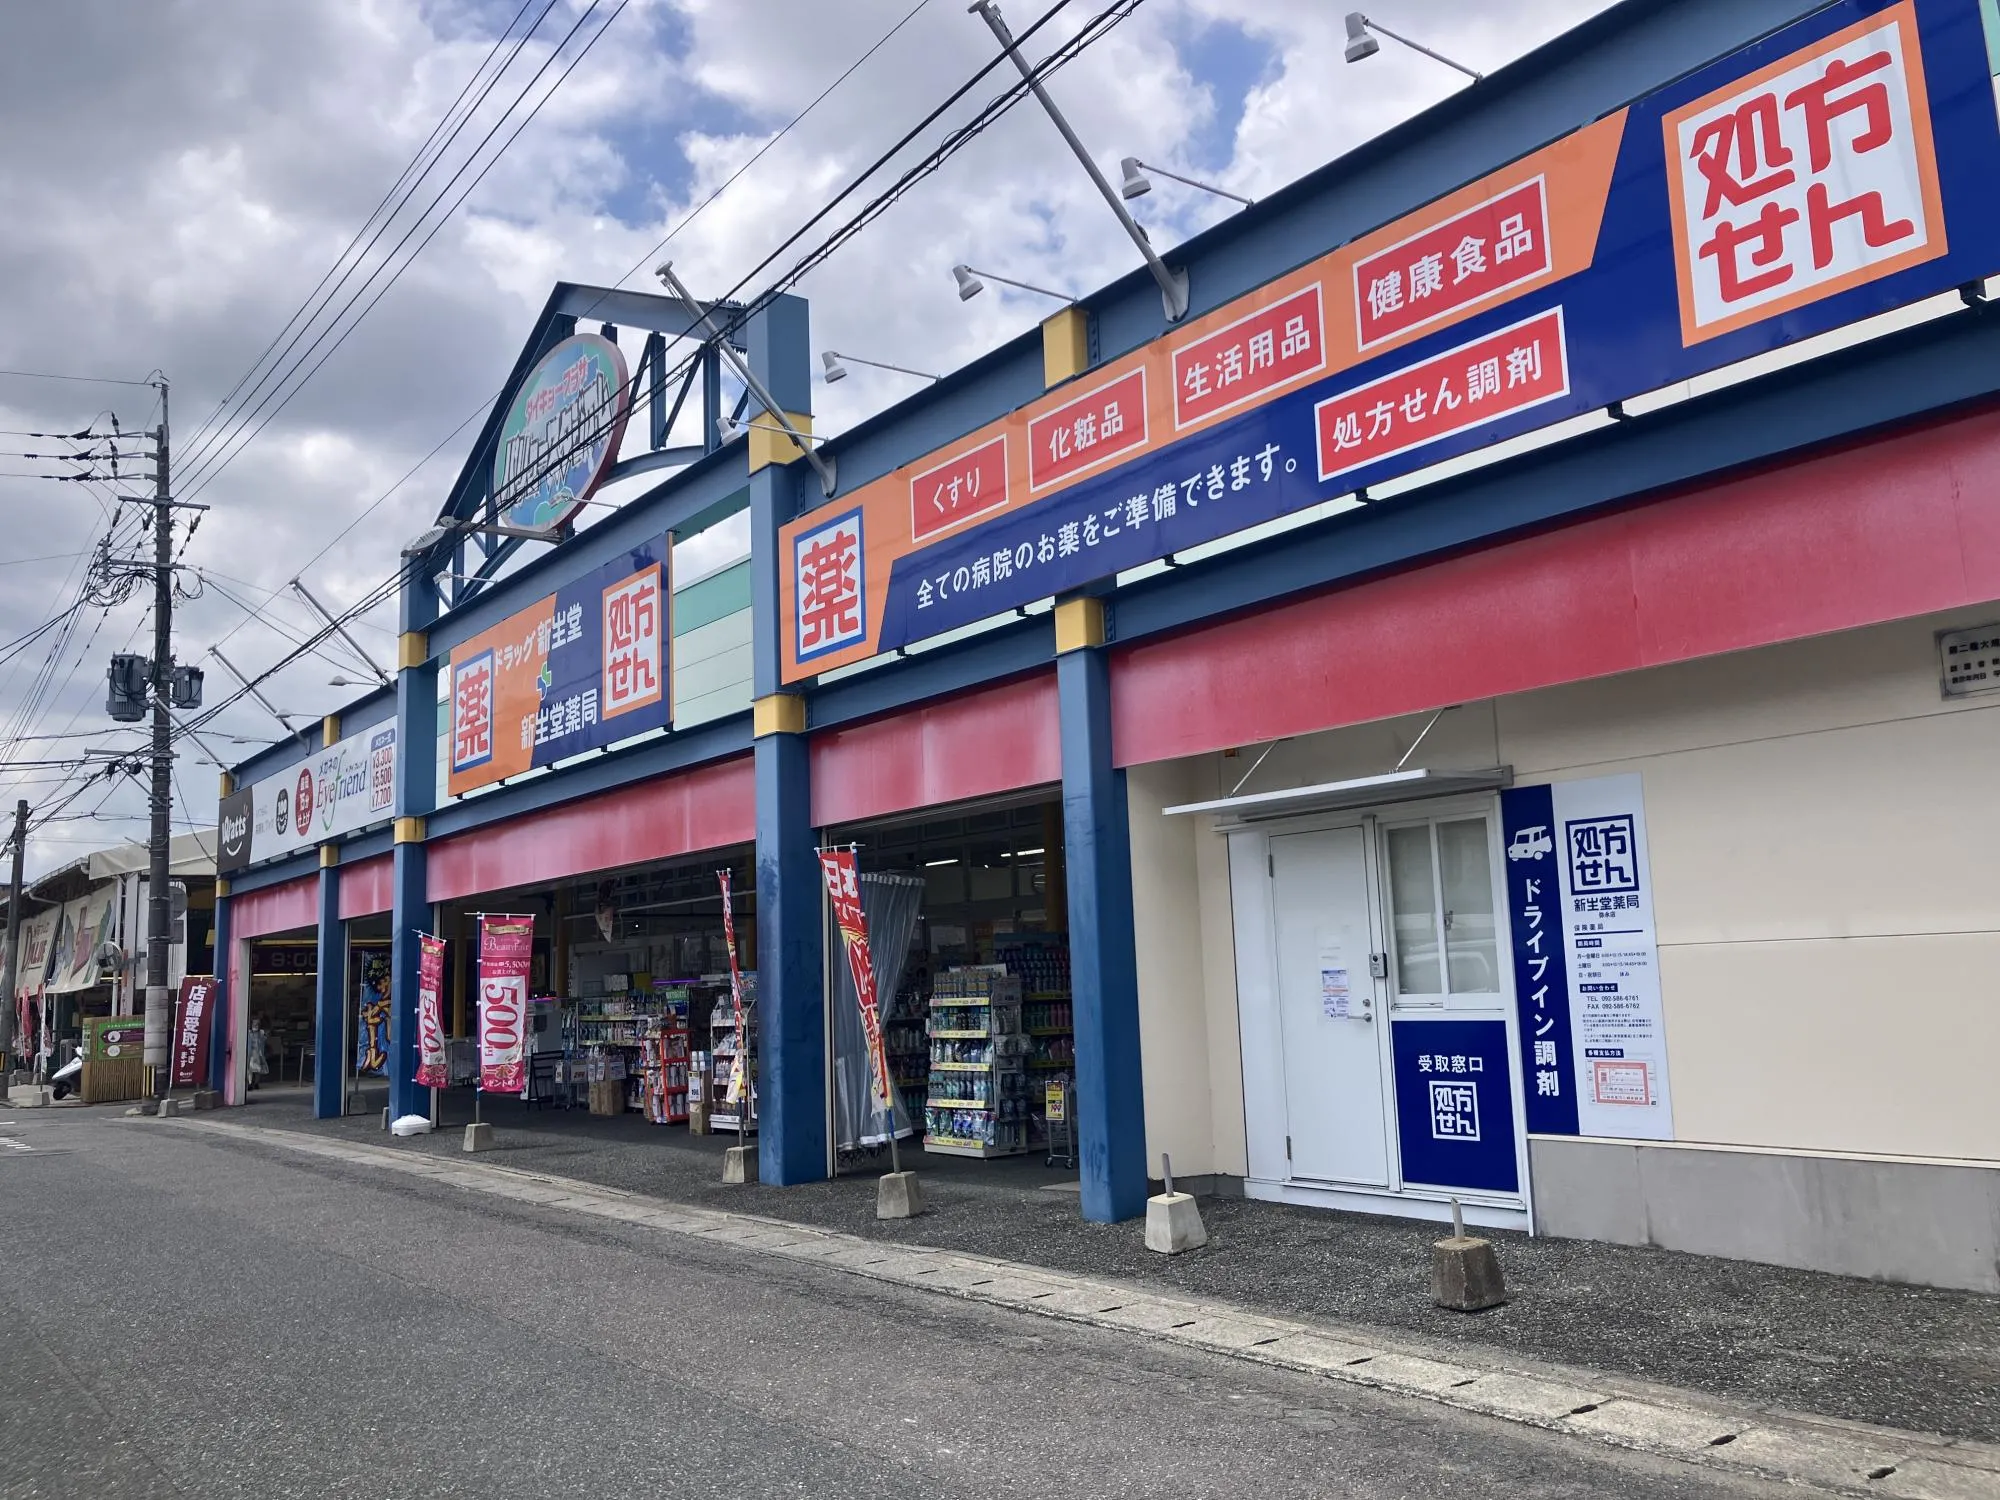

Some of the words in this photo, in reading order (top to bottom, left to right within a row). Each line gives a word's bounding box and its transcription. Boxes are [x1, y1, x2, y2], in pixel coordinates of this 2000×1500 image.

[1689, 50, 1894, 220] 処方
[1367, 211, 1535, 321] 健康食品
[1699, 181, 1915, 303] せん
[1183, 314, 1311, 404] 生活用品
[1331, 337, 1543, 454] 処方せん調剤
[1048, 401, 1126, 463] 化粧品
[932, 468, 981, 512] くすり
[915, 443, 1297, 610] 全ての病院のお薬をご準備できます。
[608, 583, 655, 653] 処方
[801, 528, 860, 647] 薬
[495, 602, 583, 676] ドラッグ新生堂
[607, 648, 656, 702] せん
[456, 665, 490, 761] 薬
[520, 688, 598, 750] 新生堂薬局
[221, 815, 247, 845] Watts
[1573, 824, 1627, 858] 処方
[1574, 894, 1640, 912] 新生堂薬局
[1575, 858, 1632, 886] せん
[1524, 878, 1560, 1097] ドライブイン調剤
[1418, 1054, 1483, 1073] 受取窓口
[1434, 1087, 1472, 1113] 処方
[1436, 1112, 1476, 1135] せん
